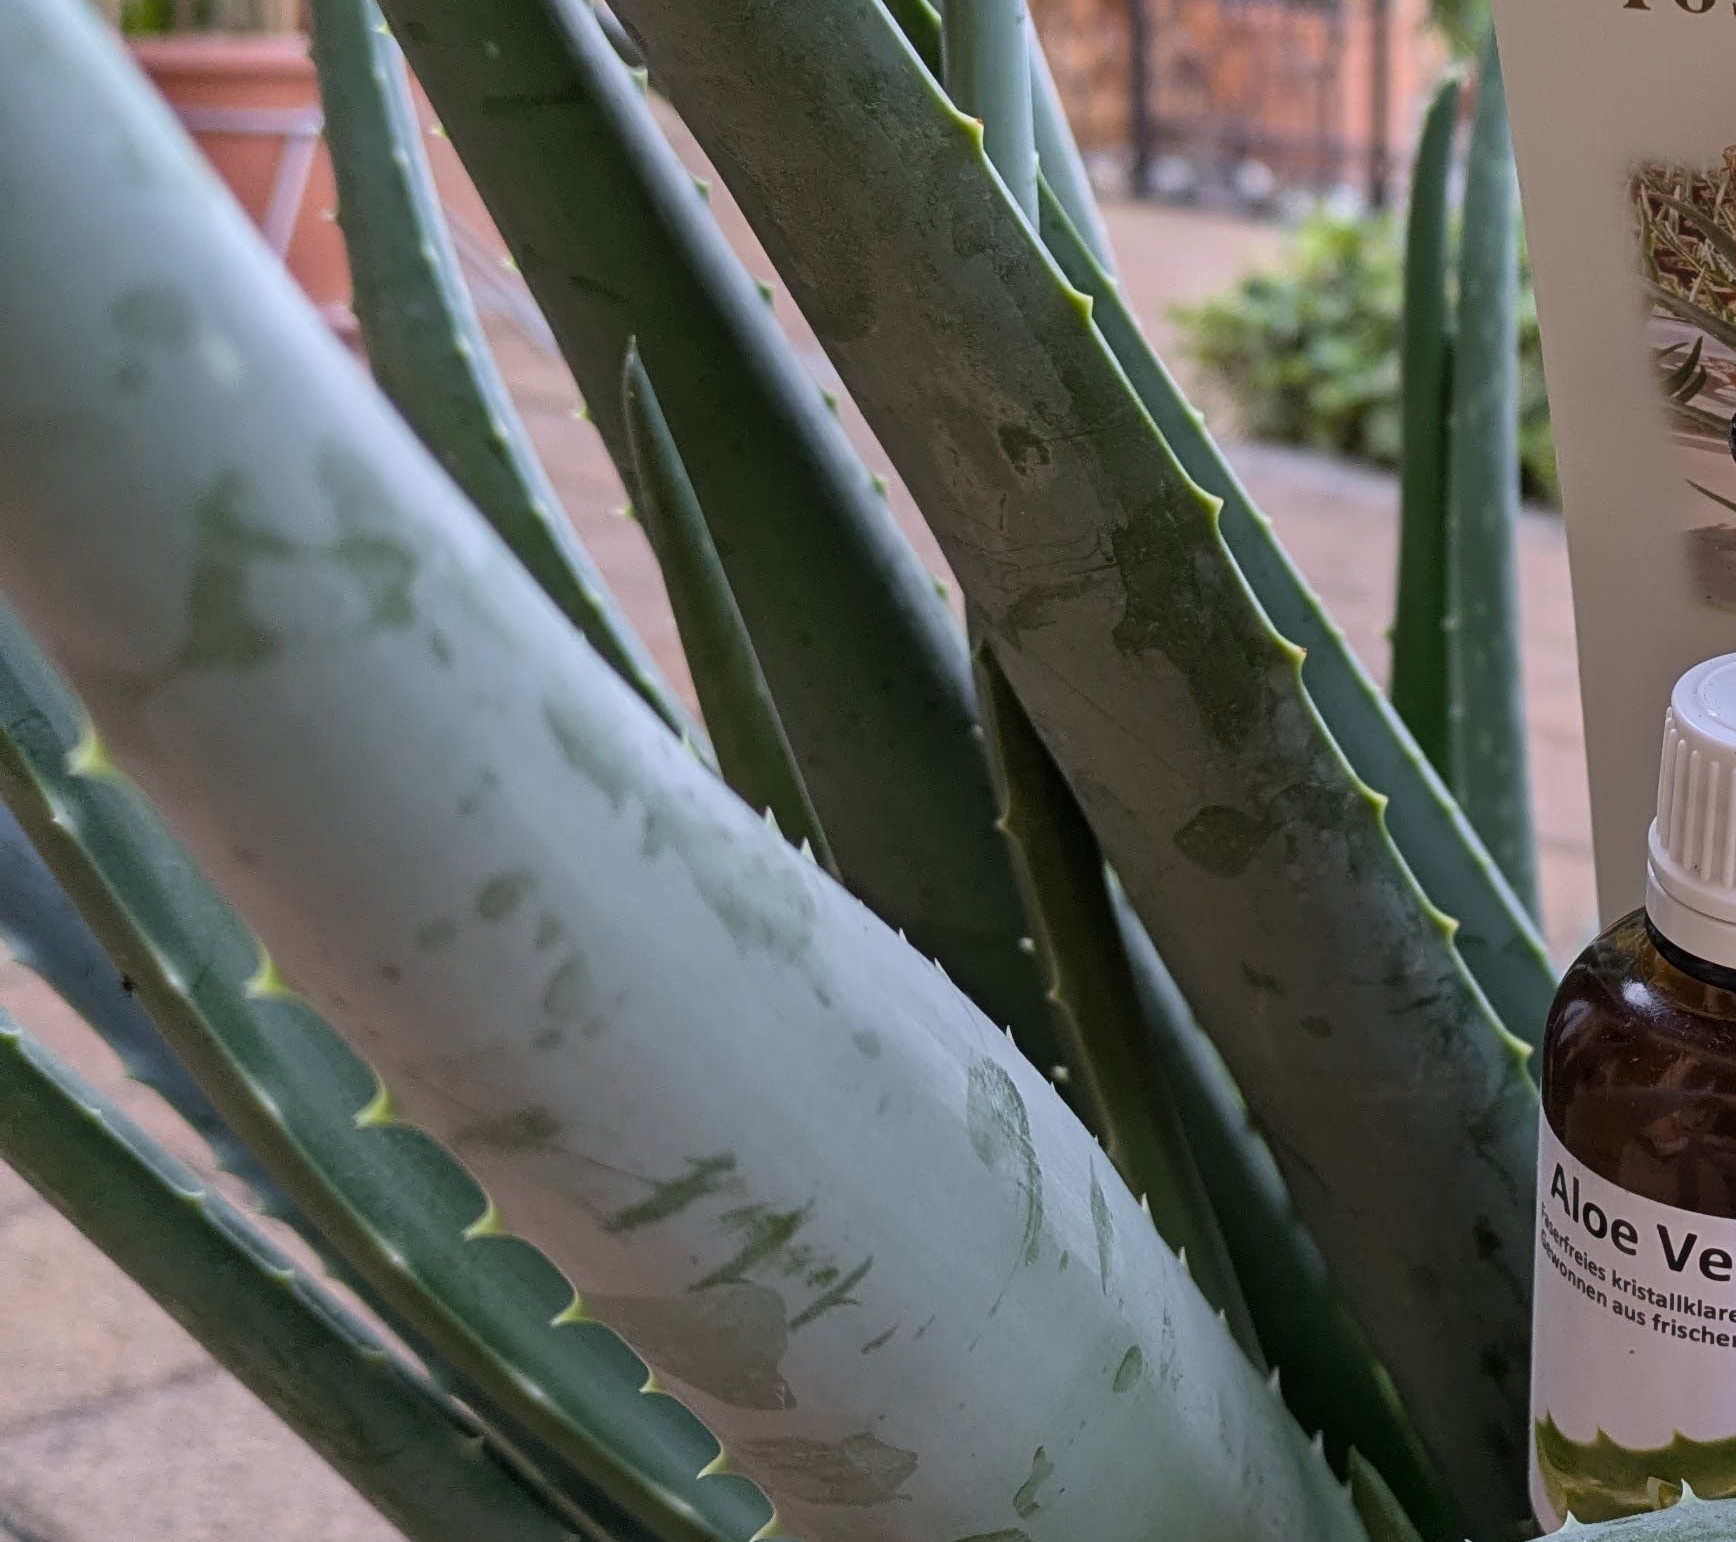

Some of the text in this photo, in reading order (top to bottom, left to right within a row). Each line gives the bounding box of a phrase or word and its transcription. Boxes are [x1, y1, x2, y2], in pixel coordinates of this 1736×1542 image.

[1541, 1201, 1606, 1281] Faserfreies
[1550, 1162, 1639, 1256] Aloe
[1541, 1228, 1608, 1308] Gewonnen
[1612, 1299, 1646, 1326] aus
